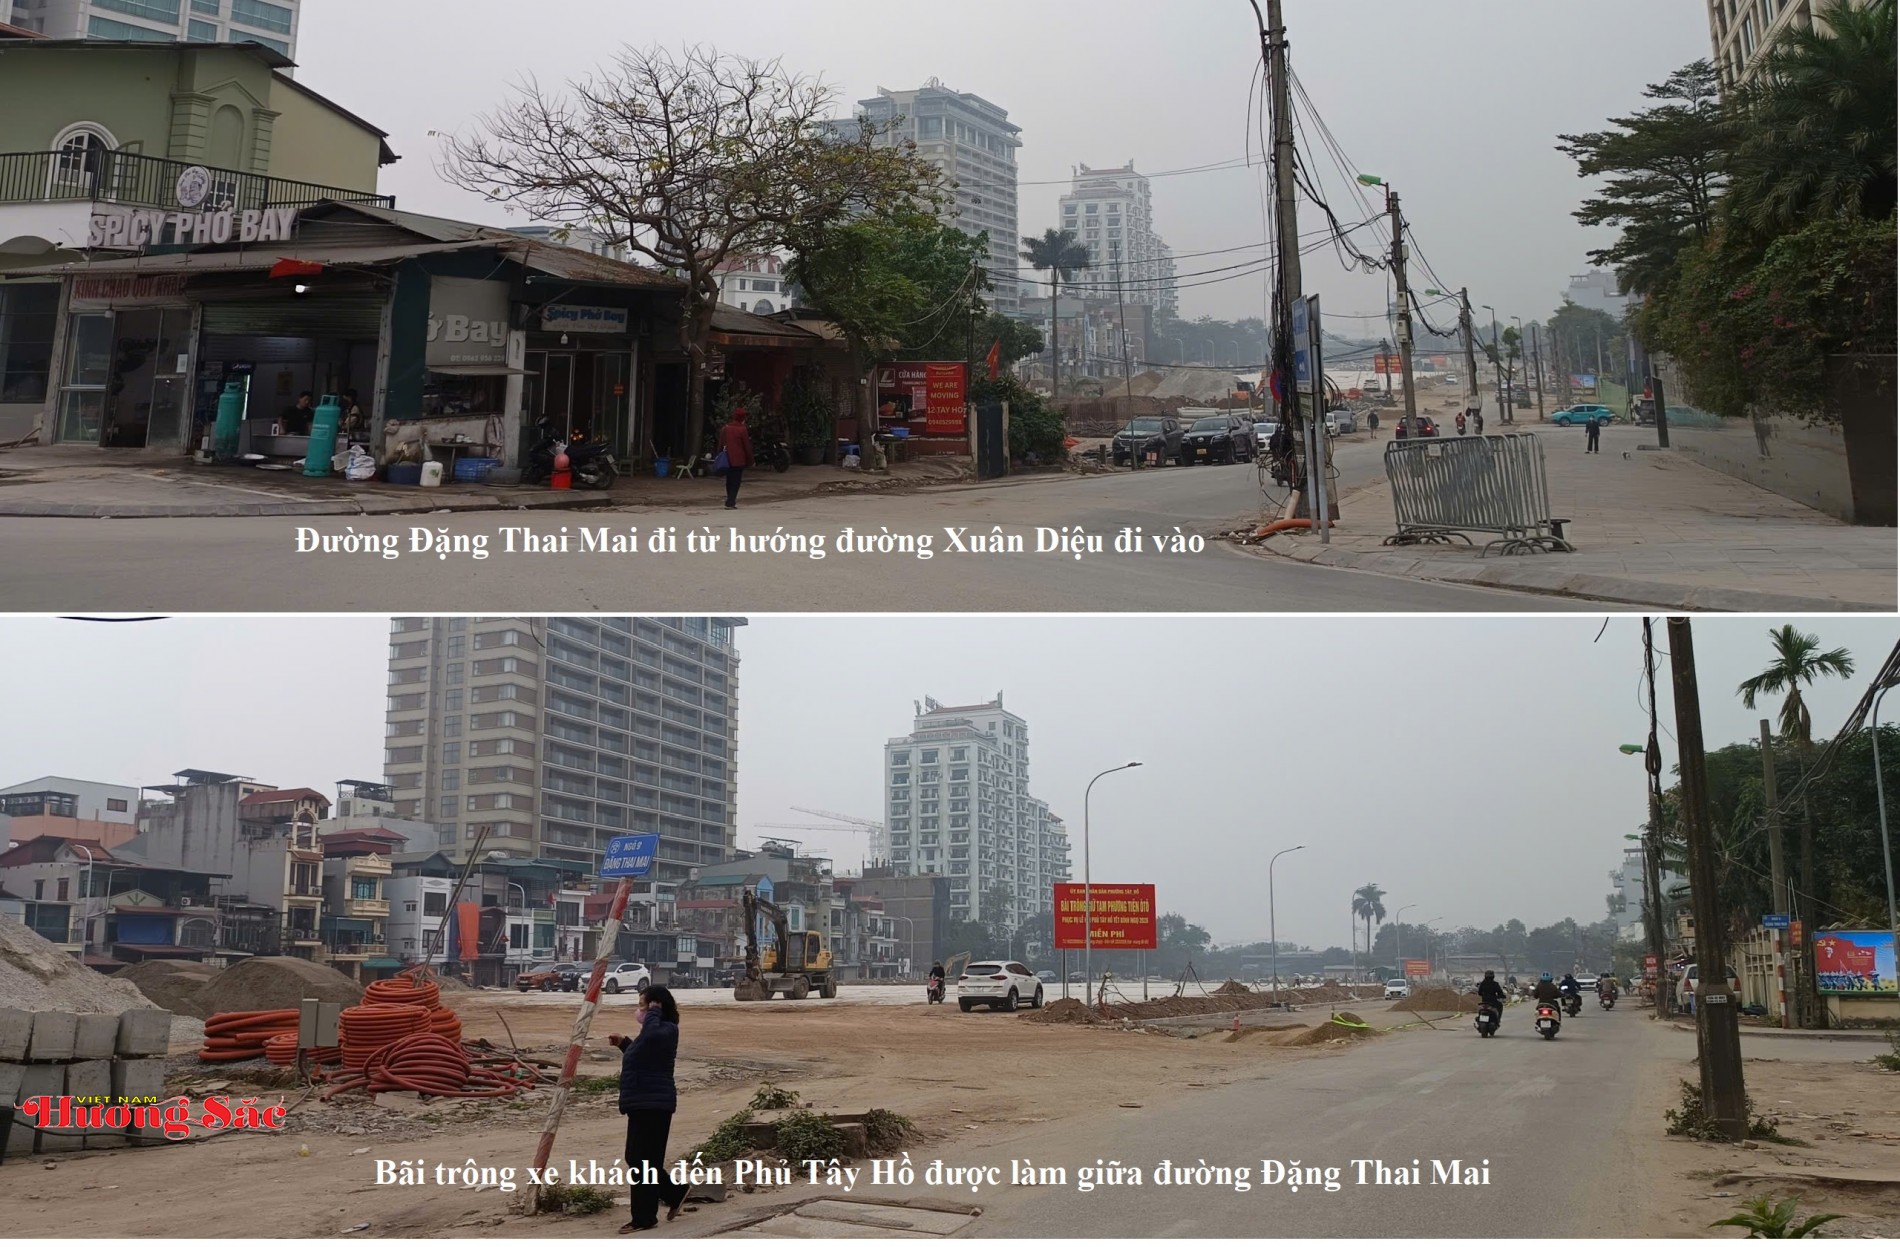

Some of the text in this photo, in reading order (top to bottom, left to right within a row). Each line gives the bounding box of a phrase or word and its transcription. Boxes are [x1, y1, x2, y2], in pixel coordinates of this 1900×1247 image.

[88, 200, 298, 247] SPICY PHỞ BAY
[547, 306, 578, 321] Spicy
[603, 310, 625, 324] Bay
[445, 314, 508, 347] Bay
[932, 381, 943, 389] WE
[944, 381, 958, 389] ARE
[930, 391, 959, 399] MOVING
[621, 856, 637, 868] THAI
[635, 856, 650, 868] MAI
[1110, 929, 1125, 938] PHÍ
